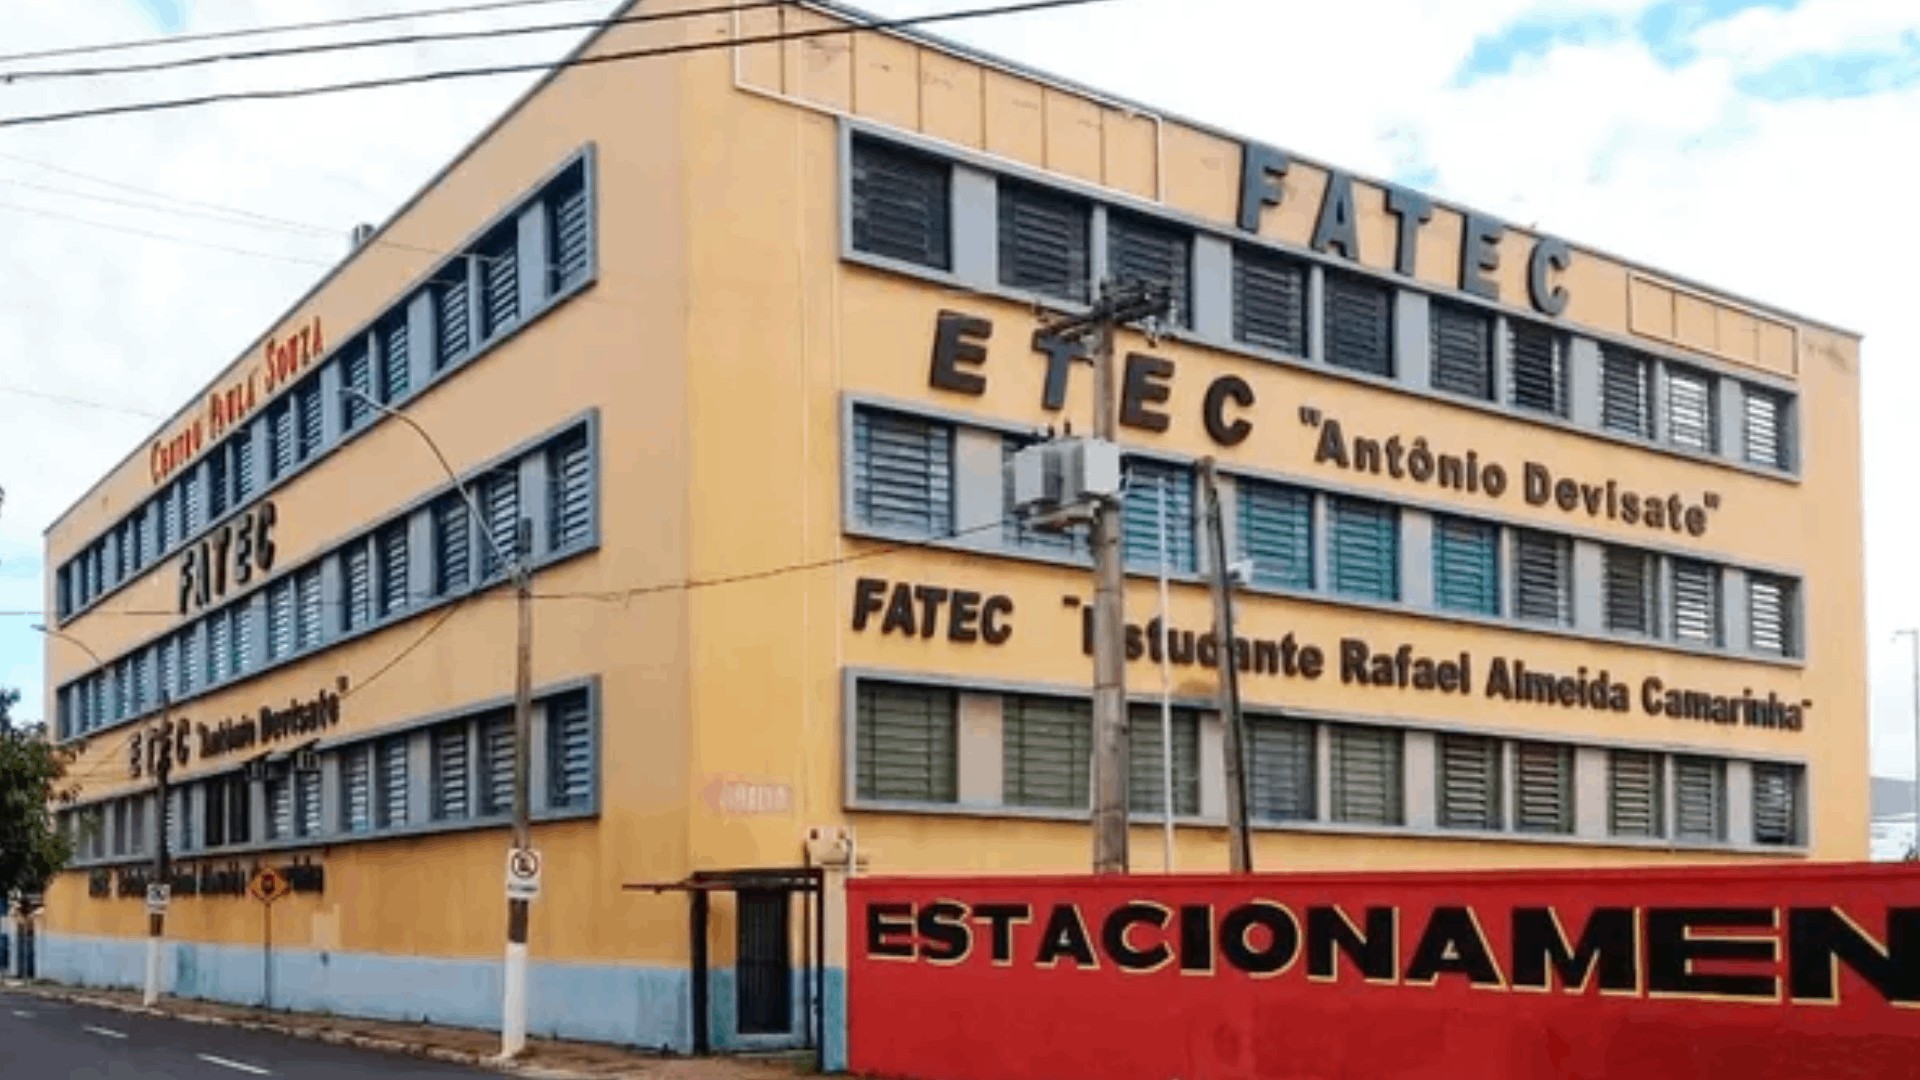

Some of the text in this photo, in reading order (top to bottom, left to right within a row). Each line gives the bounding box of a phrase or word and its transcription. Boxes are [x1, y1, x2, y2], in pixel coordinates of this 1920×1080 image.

[1237, 139, 1571, 317] FATEC
[928, 308, 1721, 538] ETEC "Antônio Devisate"
[180, 500, 278, 615] FATEC
[851, 577, 1014, 645] FATEC
[1339, 637, 1471, 695] Rafael
[1485, 655, 1630, 713] Almeida
[1641, 676, 1813, 733] Camarinha"
[866, 898, 1920, 1008] ESTACIONAMEN
